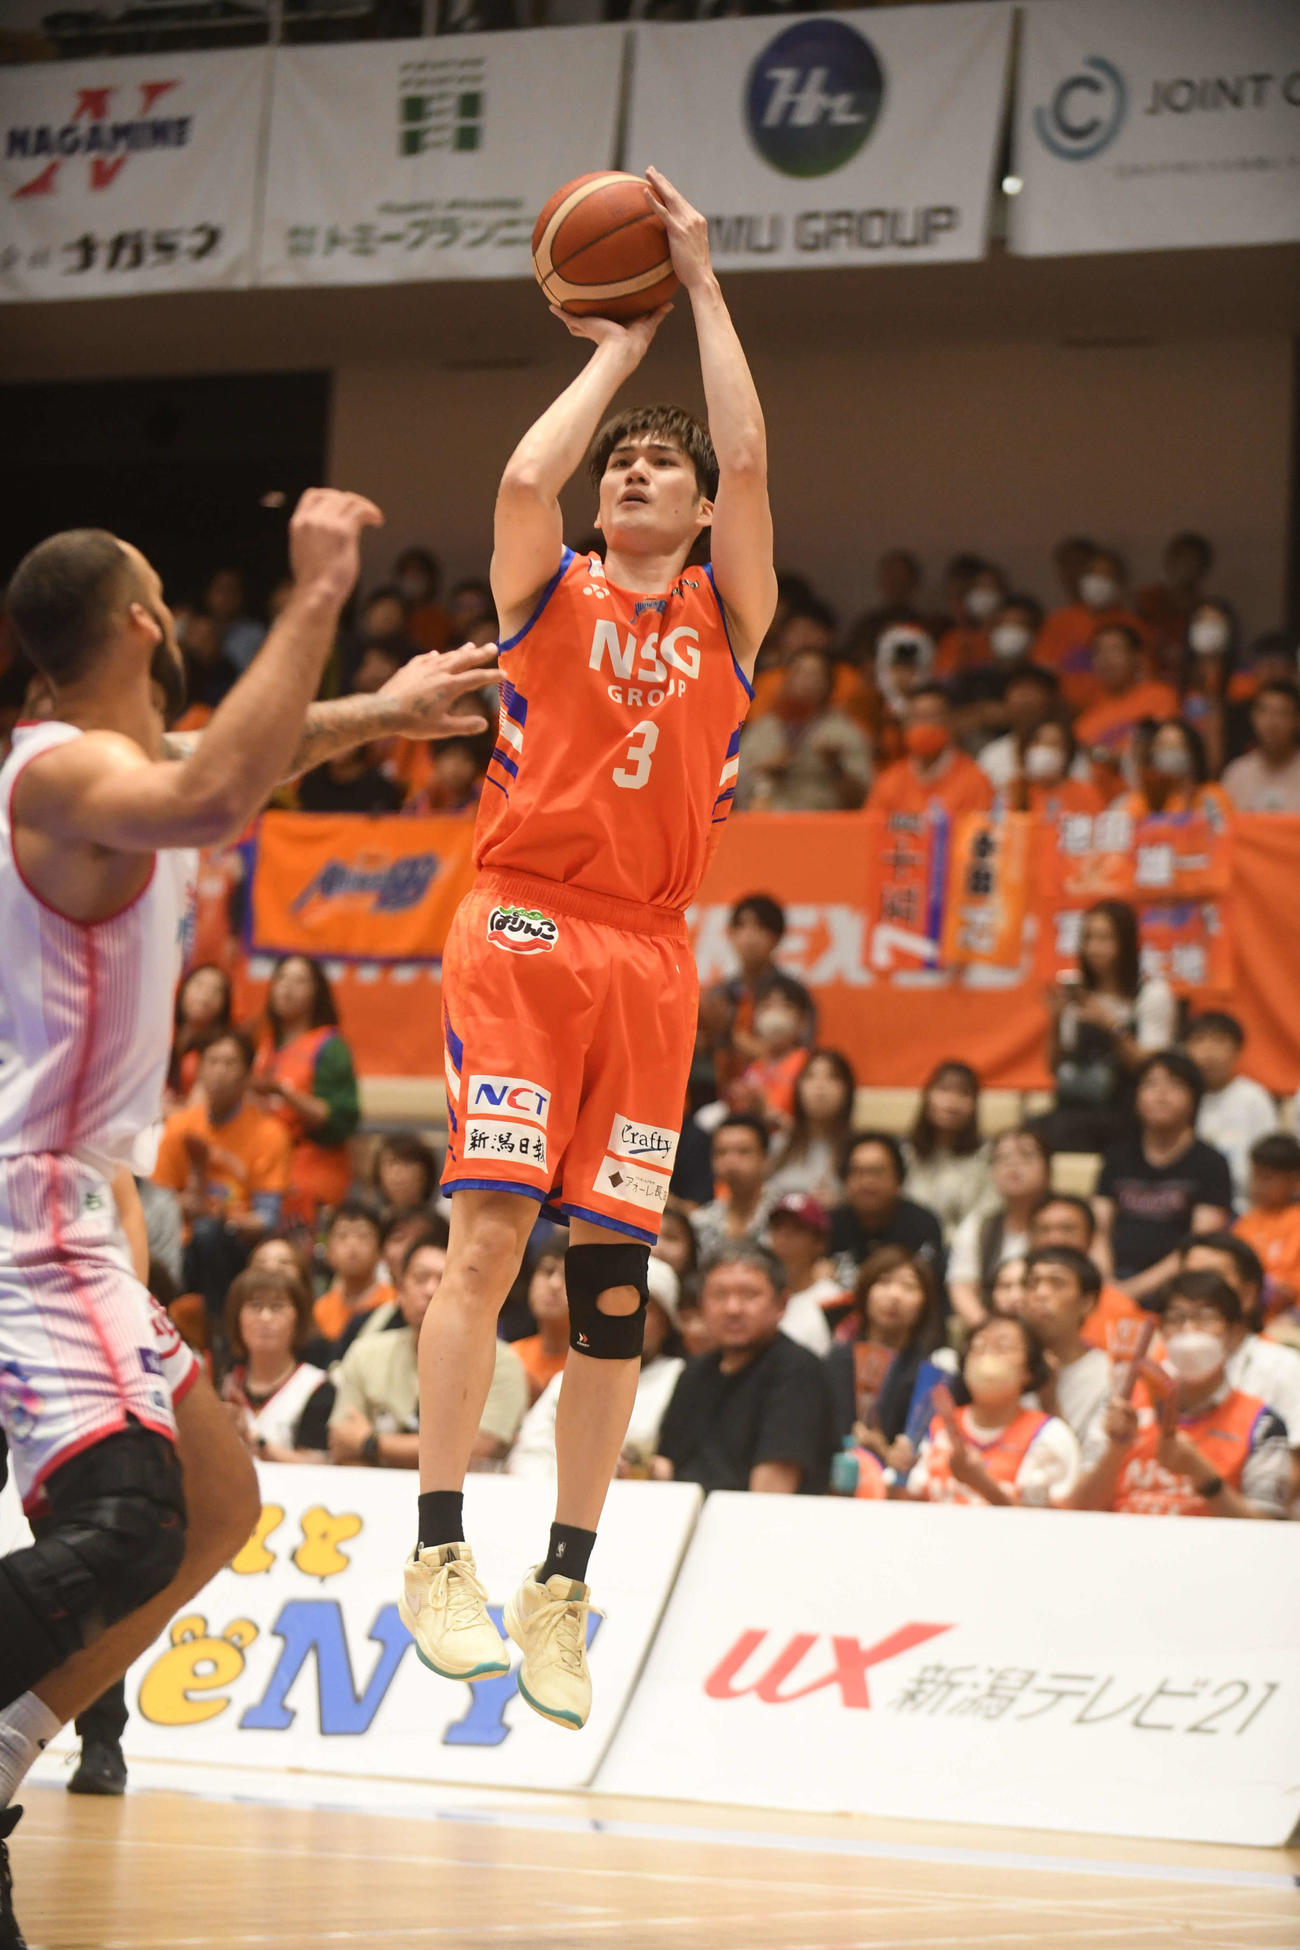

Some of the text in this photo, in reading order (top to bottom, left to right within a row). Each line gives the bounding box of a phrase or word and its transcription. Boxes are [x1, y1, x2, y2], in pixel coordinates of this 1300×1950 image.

[1145, 73, 1273, 115] JOINT
[795, 206, 957, 253] GROUP
[589, 619, 701, 683] NSG
[612, 720, 660, 790] 3
[474, 1083, 548, 1116] NCT
[621, 1123, 673, 1159] Crafty
[886, 1659, 1281, 1736] 新潟テレビ21
